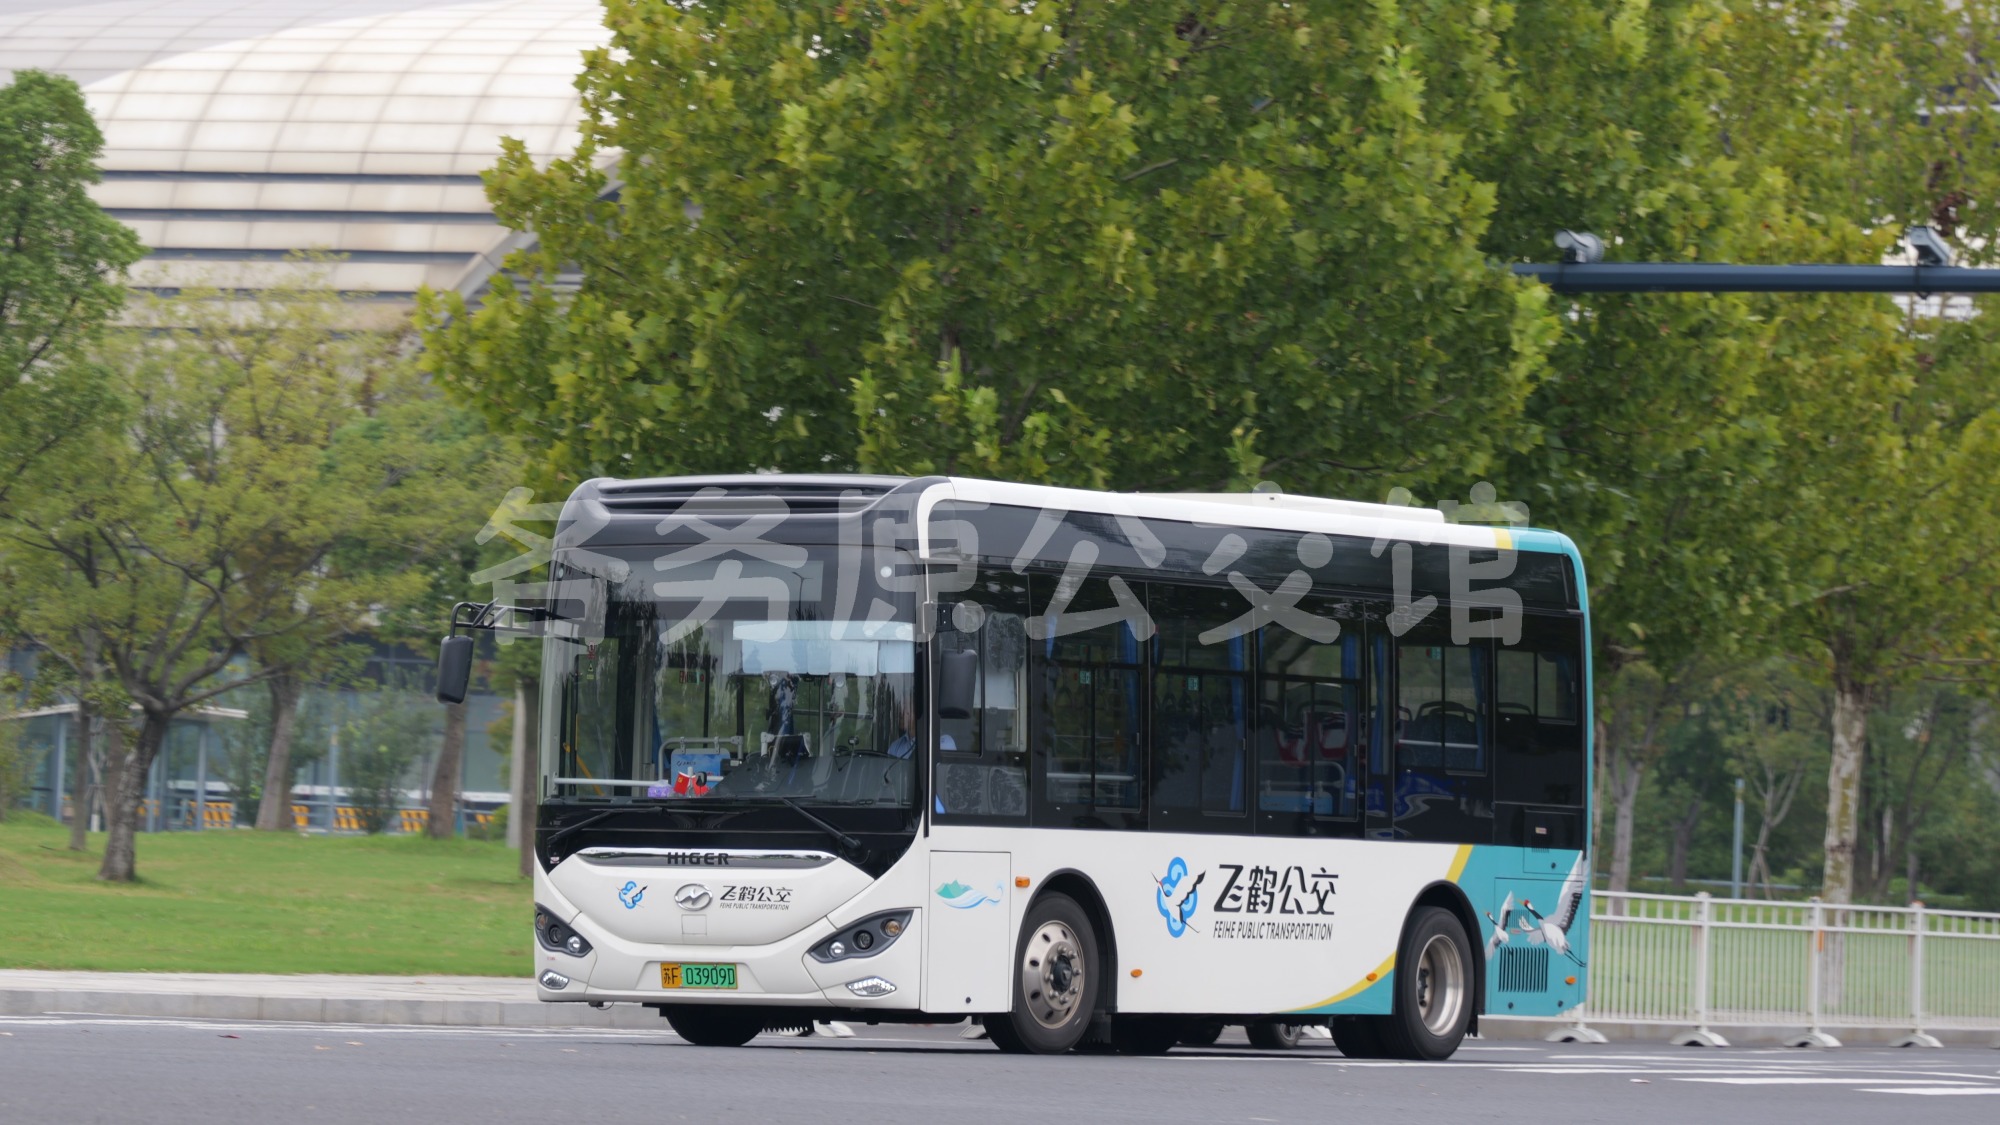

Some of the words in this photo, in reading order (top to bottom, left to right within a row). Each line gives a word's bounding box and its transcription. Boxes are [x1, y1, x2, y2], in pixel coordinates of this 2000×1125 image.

[667, 852, 729, 865] HIGER
[720, 886, 793, 902] 飞鹤公交
[1214, 864, 1339, 915] 飞鹤公交
[1213, 920, 1236, 939] FEIHE
[1236, 921, 1265, 939] PUBLIC
[1266, 923, 1333, 940] TRANSPORTATION
